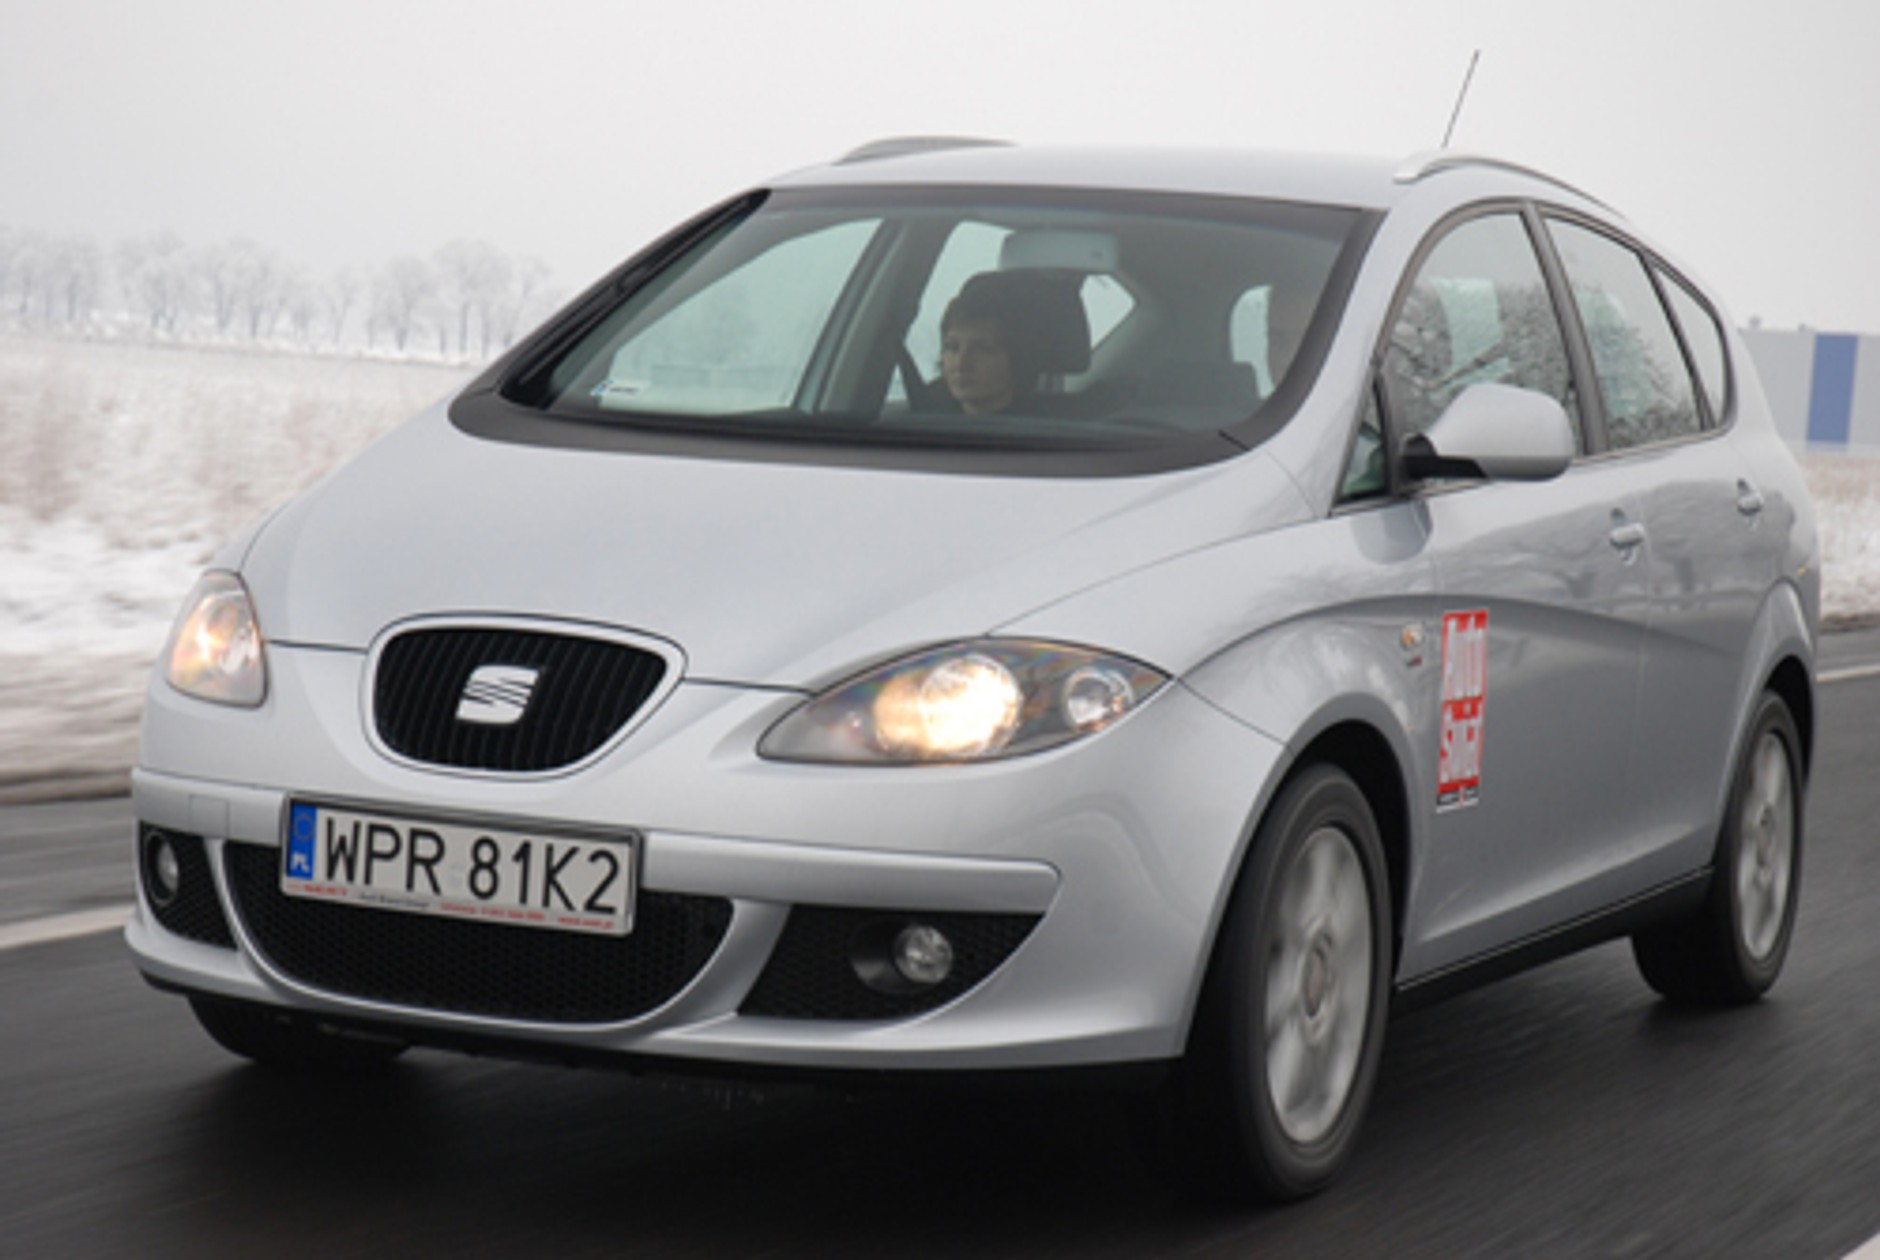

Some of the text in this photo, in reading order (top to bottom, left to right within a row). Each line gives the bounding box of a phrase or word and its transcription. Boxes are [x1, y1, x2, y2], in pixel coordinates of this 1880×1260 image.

[1441, 617, 1484, 700] Auto
[290, 852, 310, 873] PL
[325, 816, 619, 915] WPR 81K2
